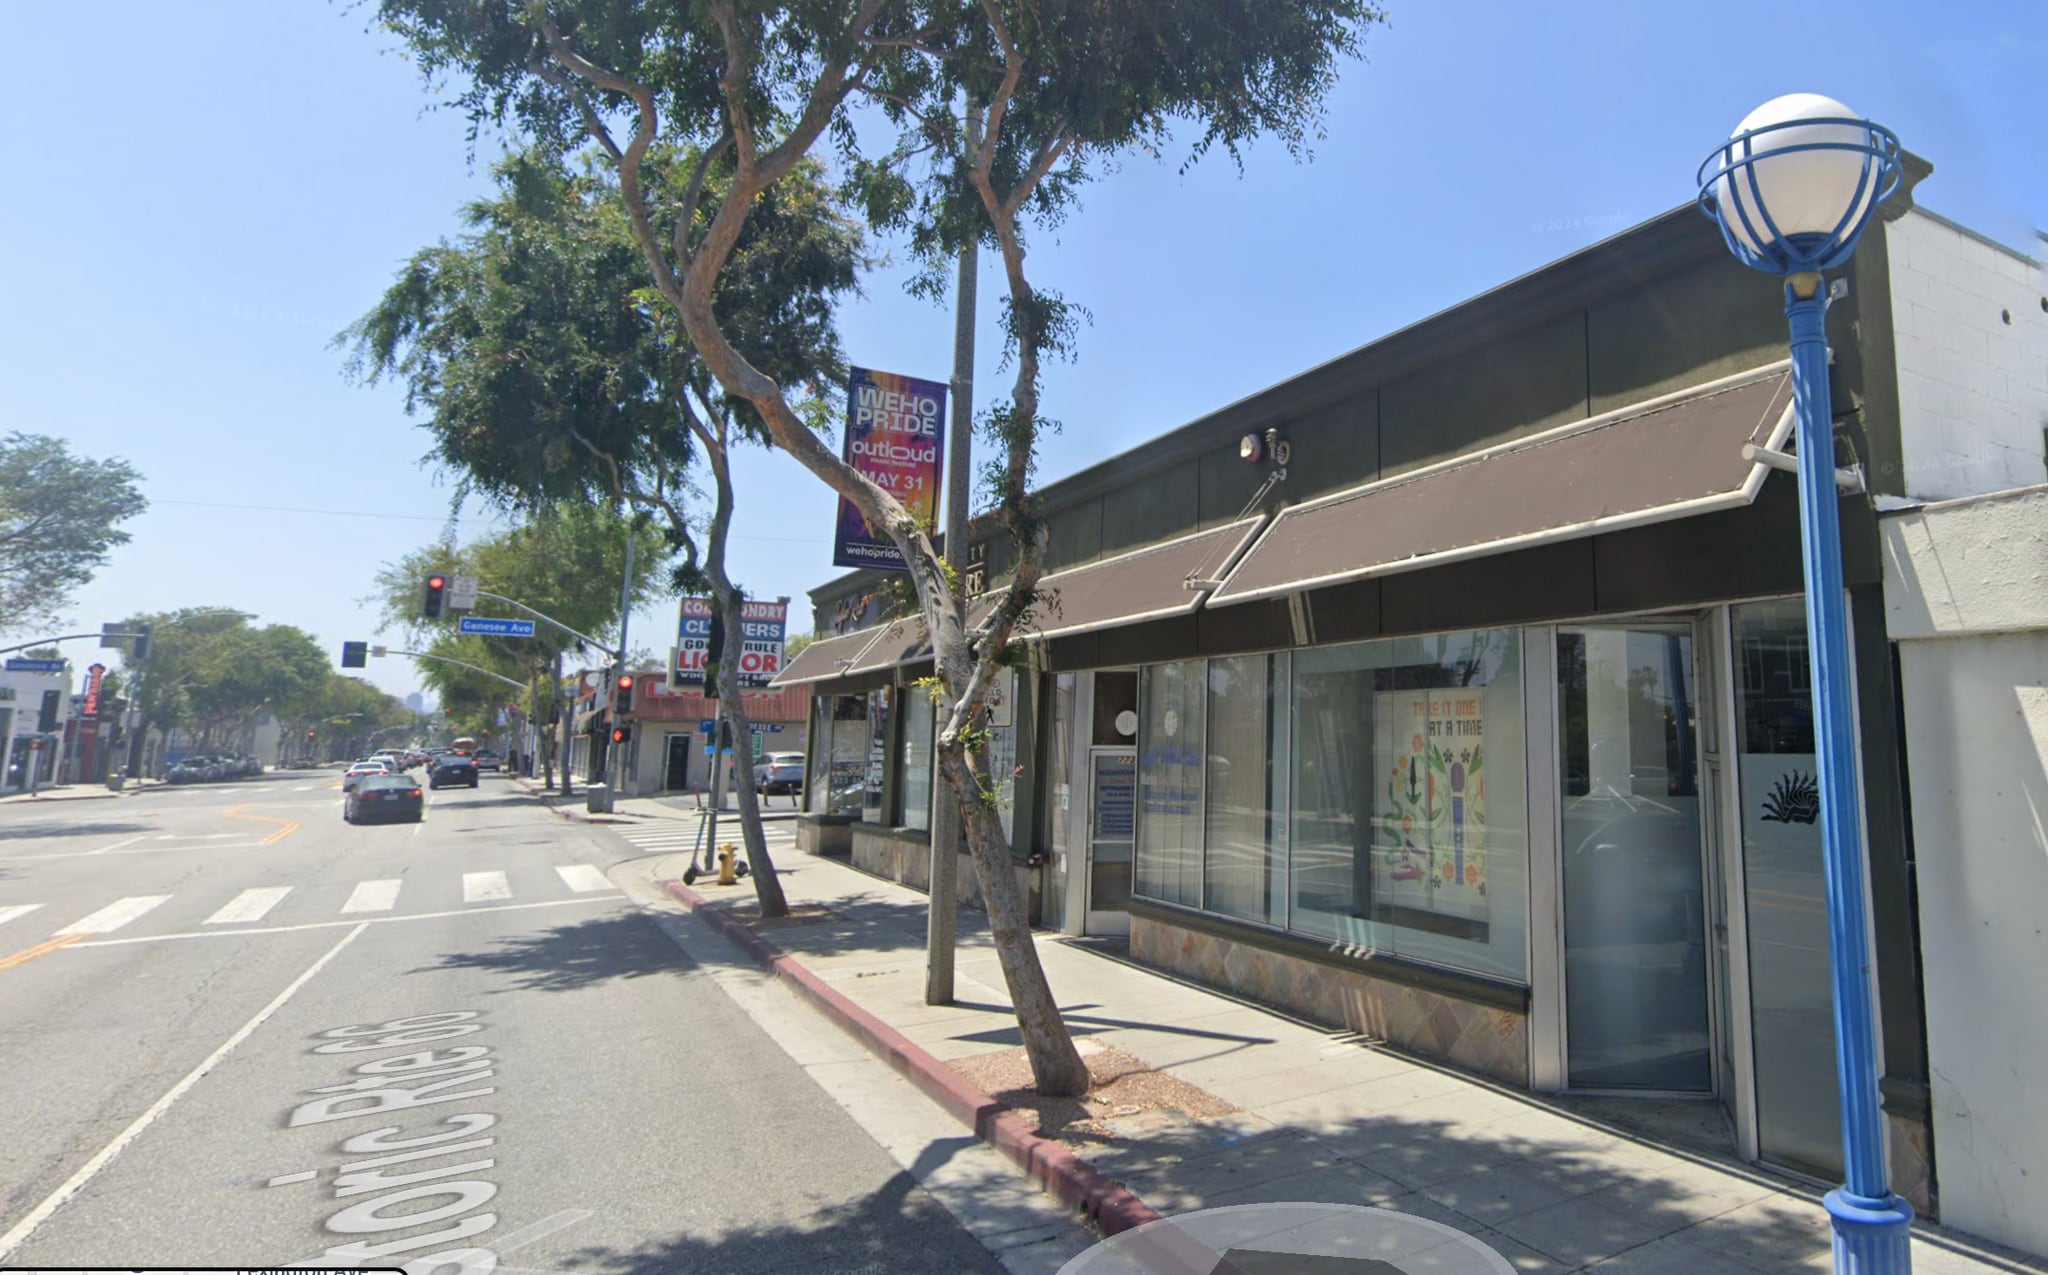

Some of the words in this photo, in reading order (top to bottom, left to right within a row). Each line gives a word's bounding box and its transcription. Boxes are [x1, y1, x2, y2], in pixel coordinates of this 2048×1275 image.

[857, 385, 938, 417] WEHO
[856, 406, 936, 436] PRIDE
[852, 440, 936, 464] outloud
[860, 469, 900, 489] MAY
[904, 475, 924, 491] 31
[463, 620, 507, 632] Genesee
[510, 623, 531, 633] Ave
[685, 618, 781, 638] CLERS
[744, 642, 777, 654] RULE
[679, 650, 778, 673] LIOR
[1442, 701, 1452, 716] IT
[1455, 700, 1476, 716] ONE
[1429, 721, 1443, 736] AT
[1445, 720, 1454, 736] A
[1456, 719, 1483, 736] TIME
